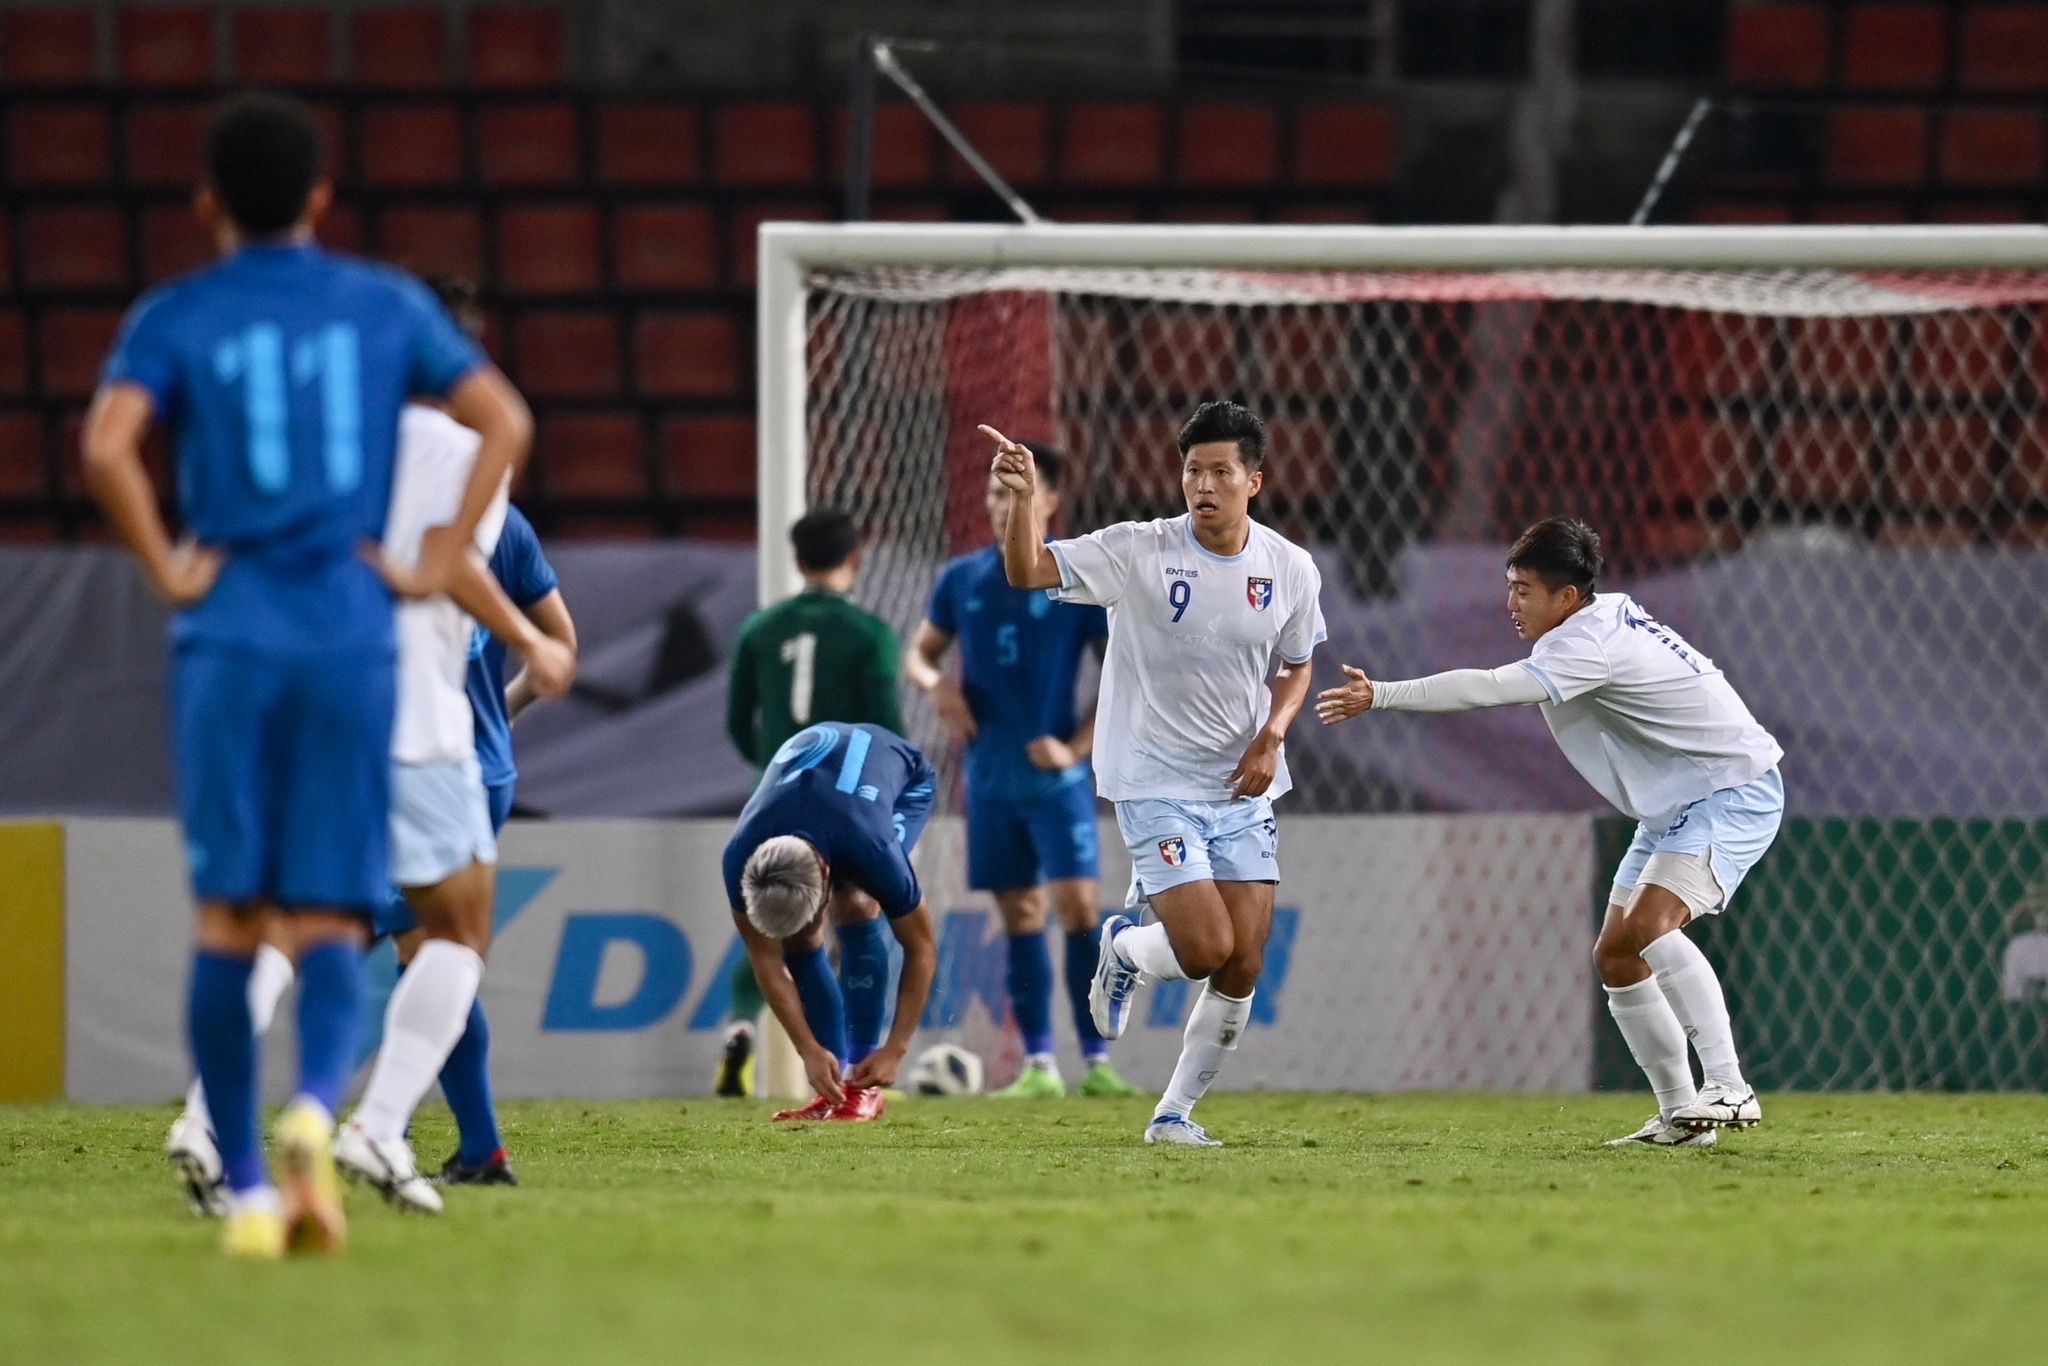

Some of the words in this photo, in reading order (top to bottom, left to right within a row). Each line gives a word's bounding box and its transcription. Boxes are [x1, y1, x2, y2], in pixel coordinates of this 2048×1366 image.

[213, 323, 362, 493] 11
[1165, 567, 1198, 577] ENTES
[1169, 580, 1191, 623] 9
[997, 623, 1018, 667] 5
[779, 632, 816, 724] 1
